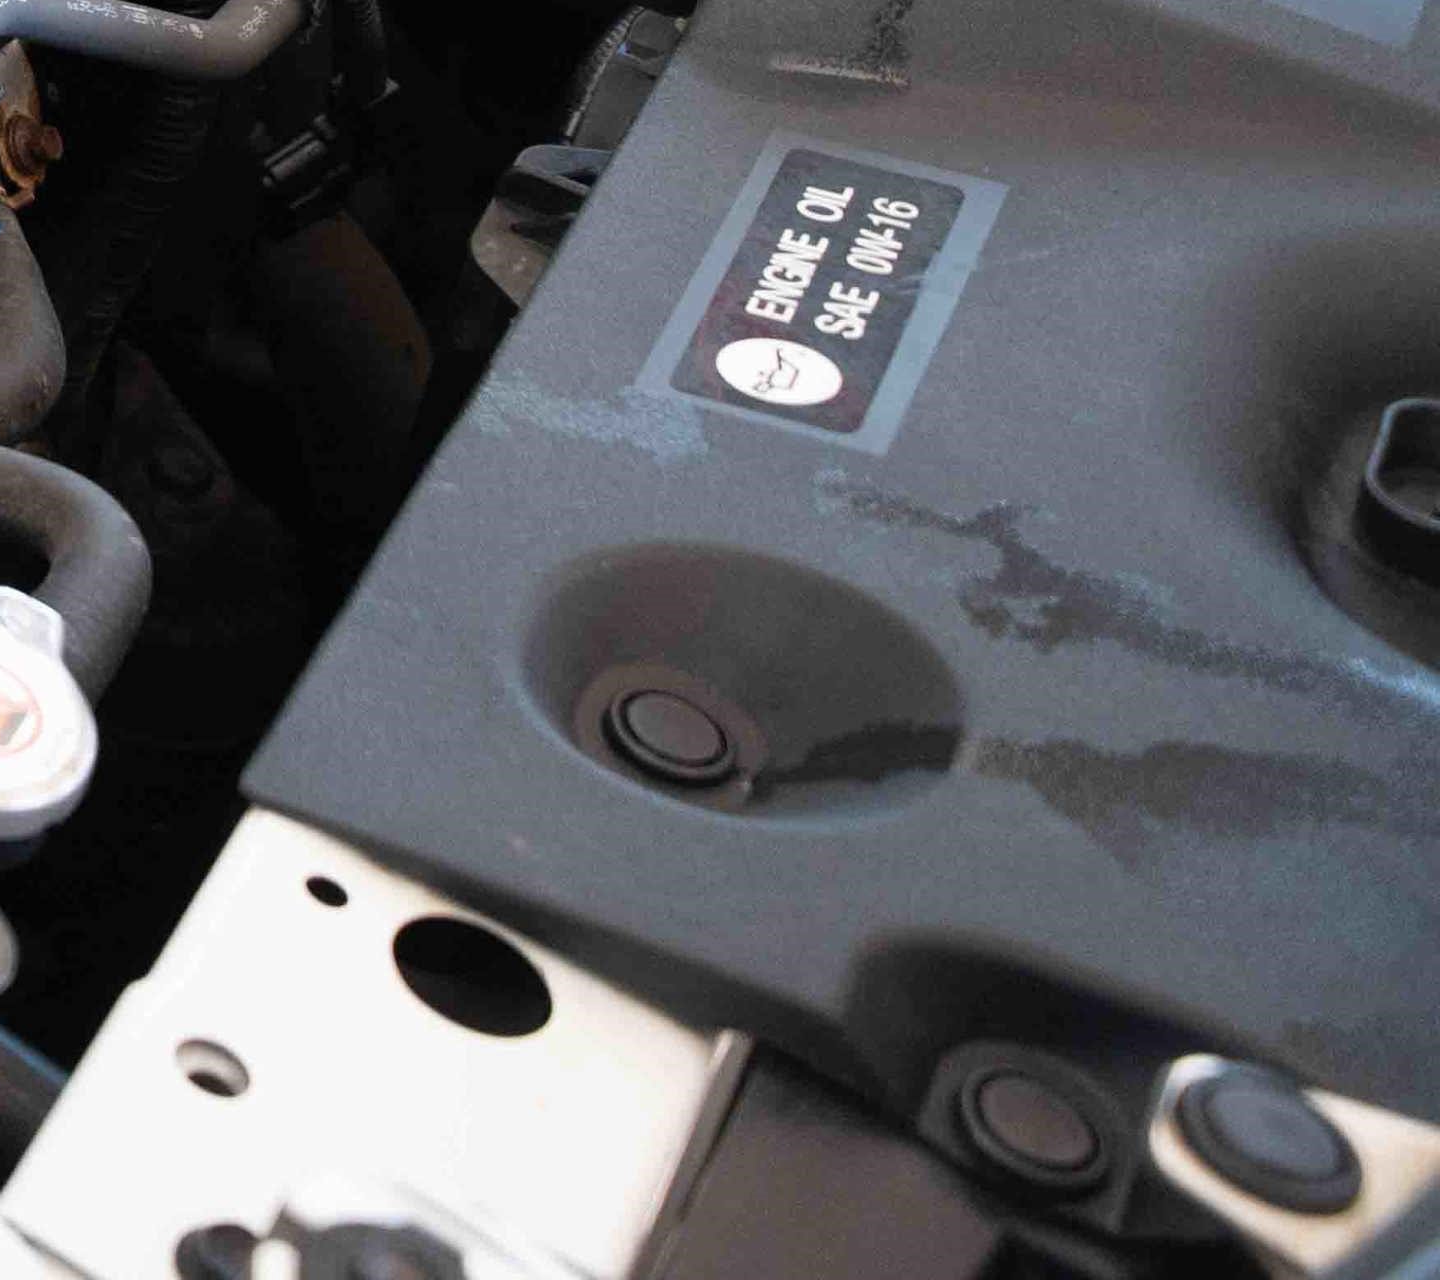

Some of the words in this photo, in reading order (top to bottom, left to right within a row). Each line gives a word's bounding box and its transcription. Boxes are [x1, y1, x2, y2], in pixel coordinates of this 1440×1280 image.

[745, 228, 828, 324] ENGINE
[796, 185, 854, 223] OIL
[846, 196, 920, 276] 0W-16
[815, 281, 879, 340] SAE
